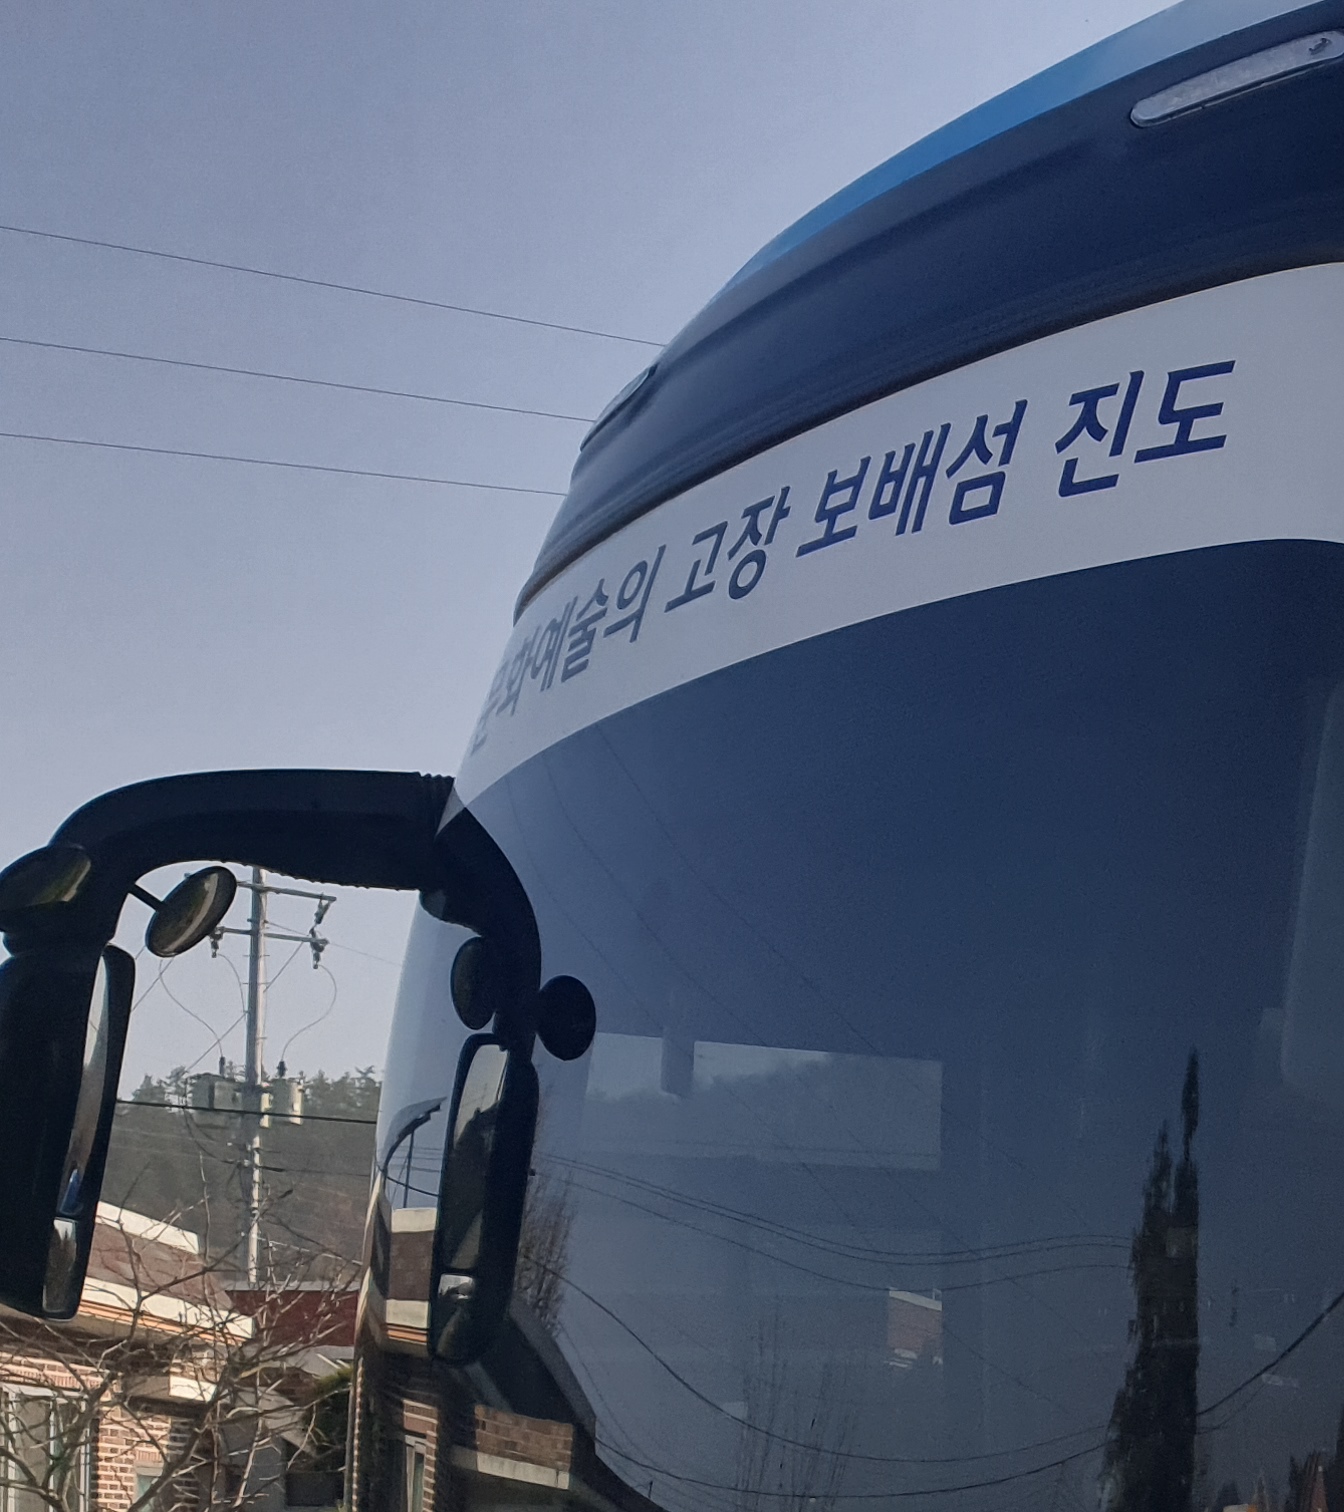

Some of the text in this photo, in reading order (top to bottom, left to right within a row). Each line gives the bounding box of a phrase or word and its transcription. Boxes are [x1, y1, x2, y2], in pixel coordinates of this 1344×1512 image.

[664, 485, 791, 612] 고장
[796, 400, 1028, 558] 보배섬
[1053, 360, 1236, 497] 진도
